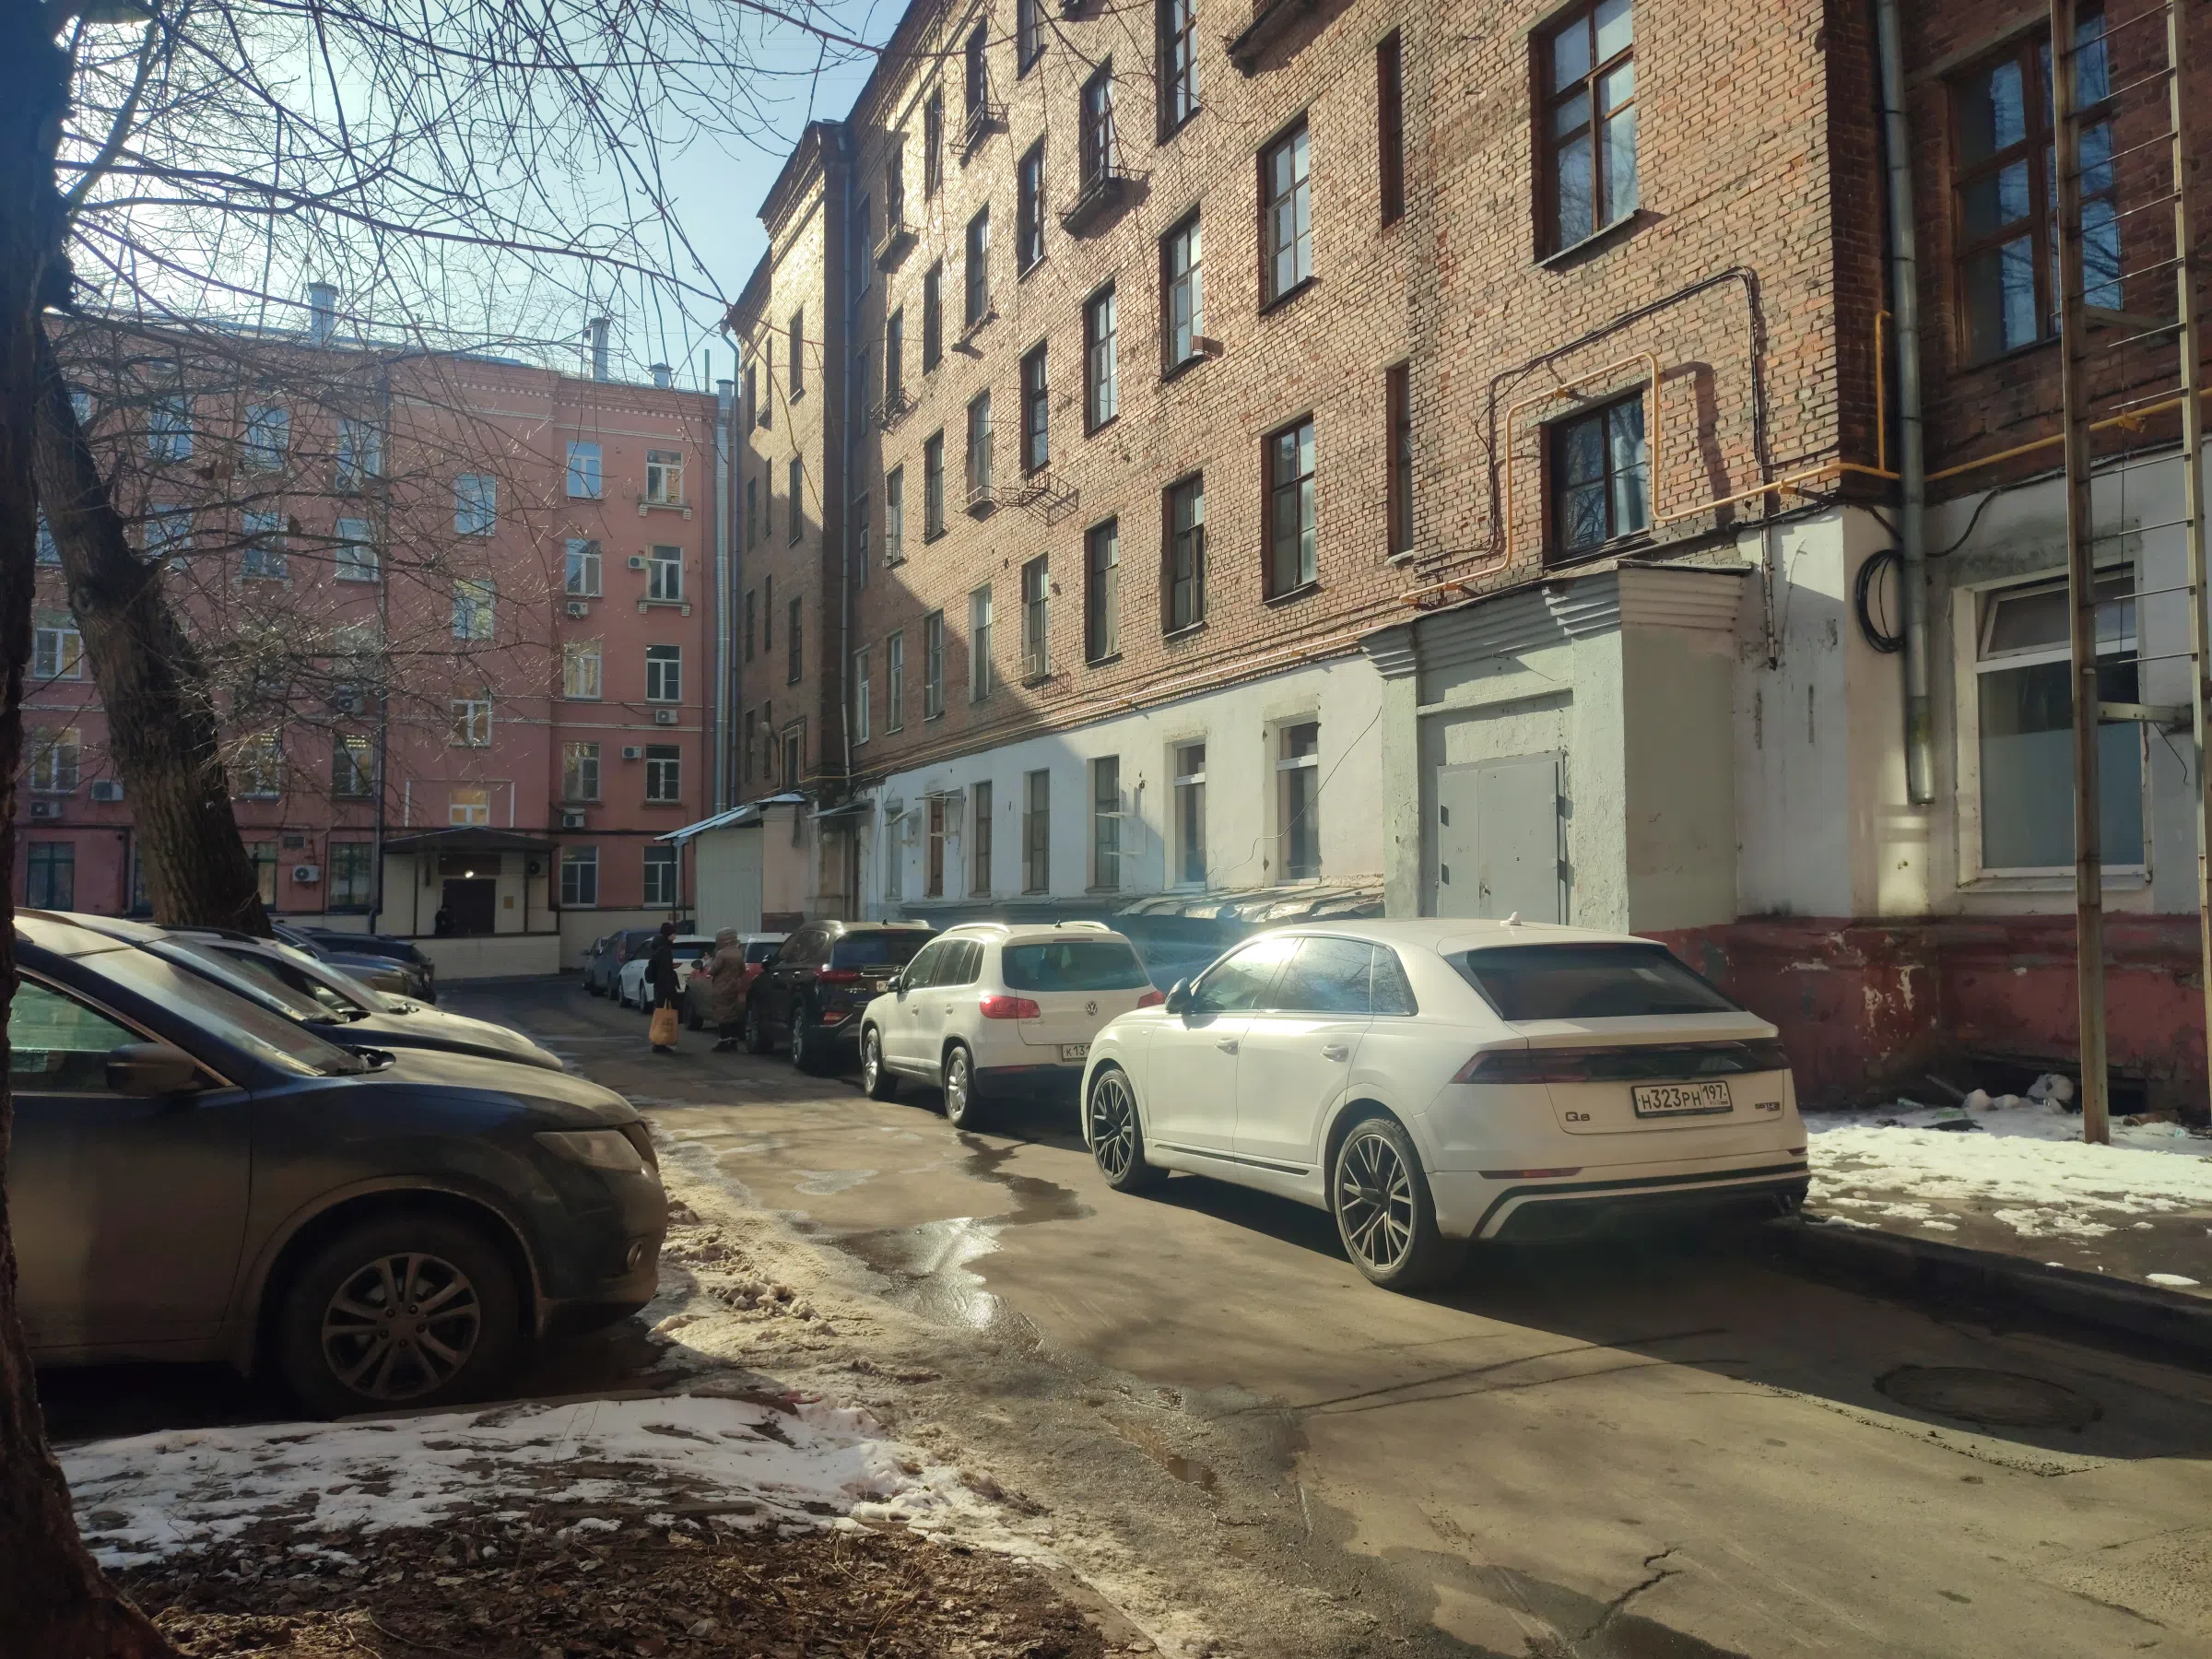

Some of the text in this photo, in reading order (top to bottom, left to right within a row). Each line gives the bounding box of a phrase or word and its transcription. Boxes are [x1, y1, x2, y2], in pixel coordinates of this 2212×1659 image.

[1641, 1085, 1723, 1110] Н323РН 197
[1565, 1112, 1590, 1122] Q8
